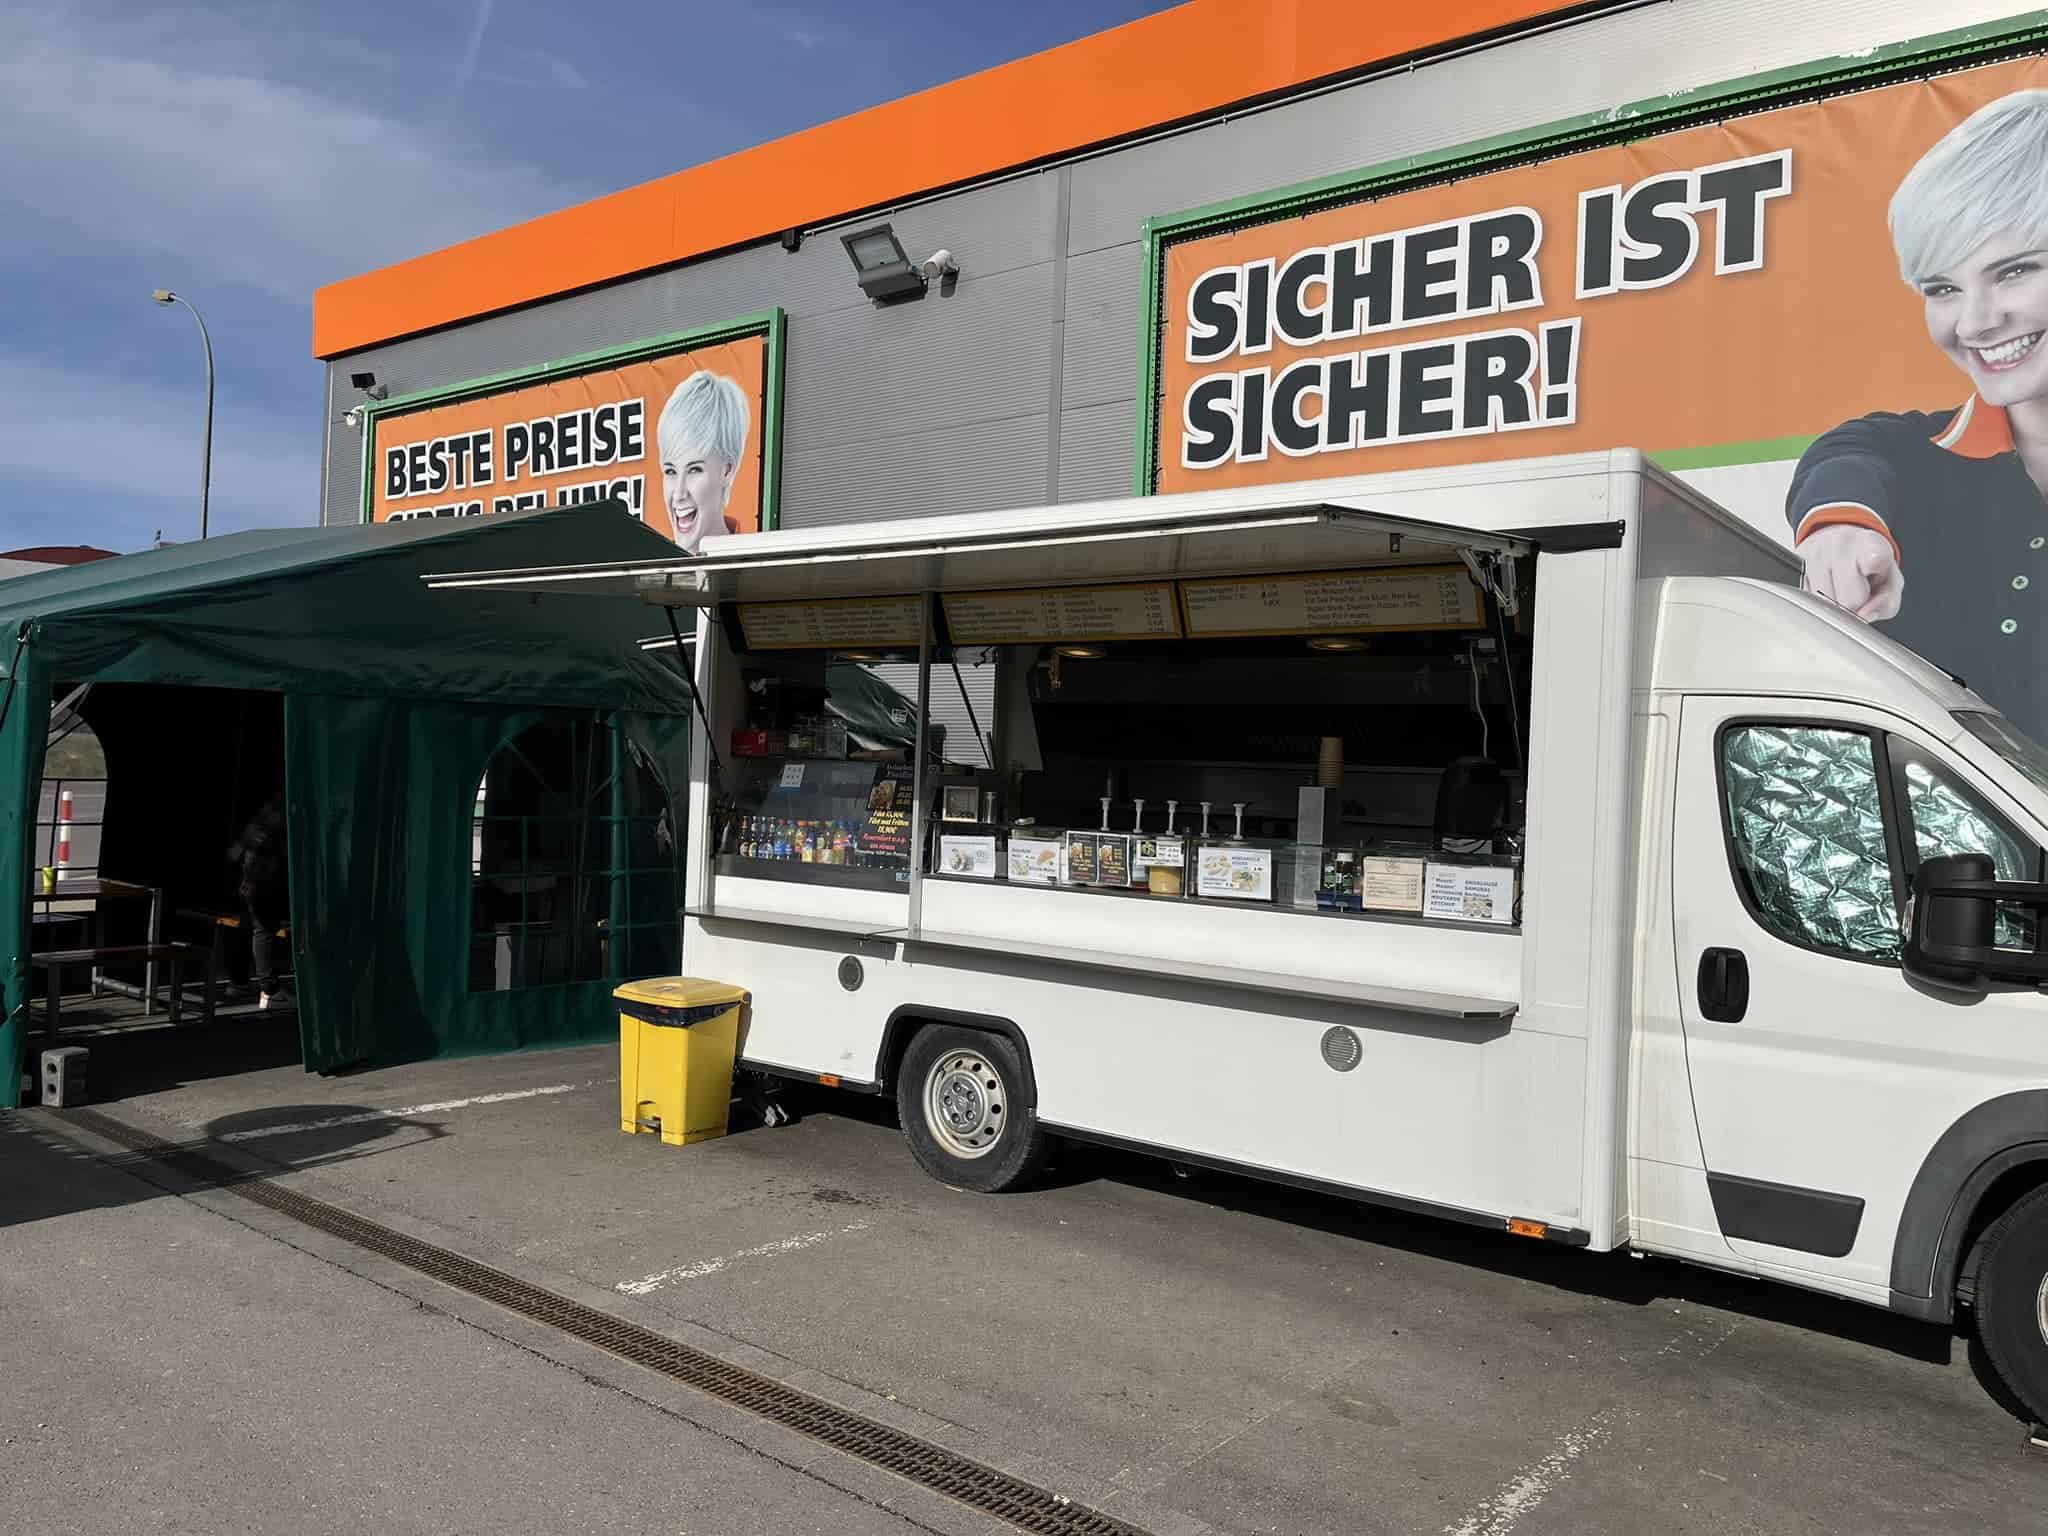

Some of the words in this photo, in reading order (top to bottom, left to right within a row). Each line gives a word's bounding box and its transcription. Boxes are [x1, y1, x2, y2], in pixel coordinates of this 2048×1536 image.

[1186, 207, 1544, 363] SICHER
[1576, 149, 1792, 299] IST
[384, 428, 494, 499] BESTE
[504, 397, 645, 481] PREISE
[1181, 317, 1581, 469] SICHER!
